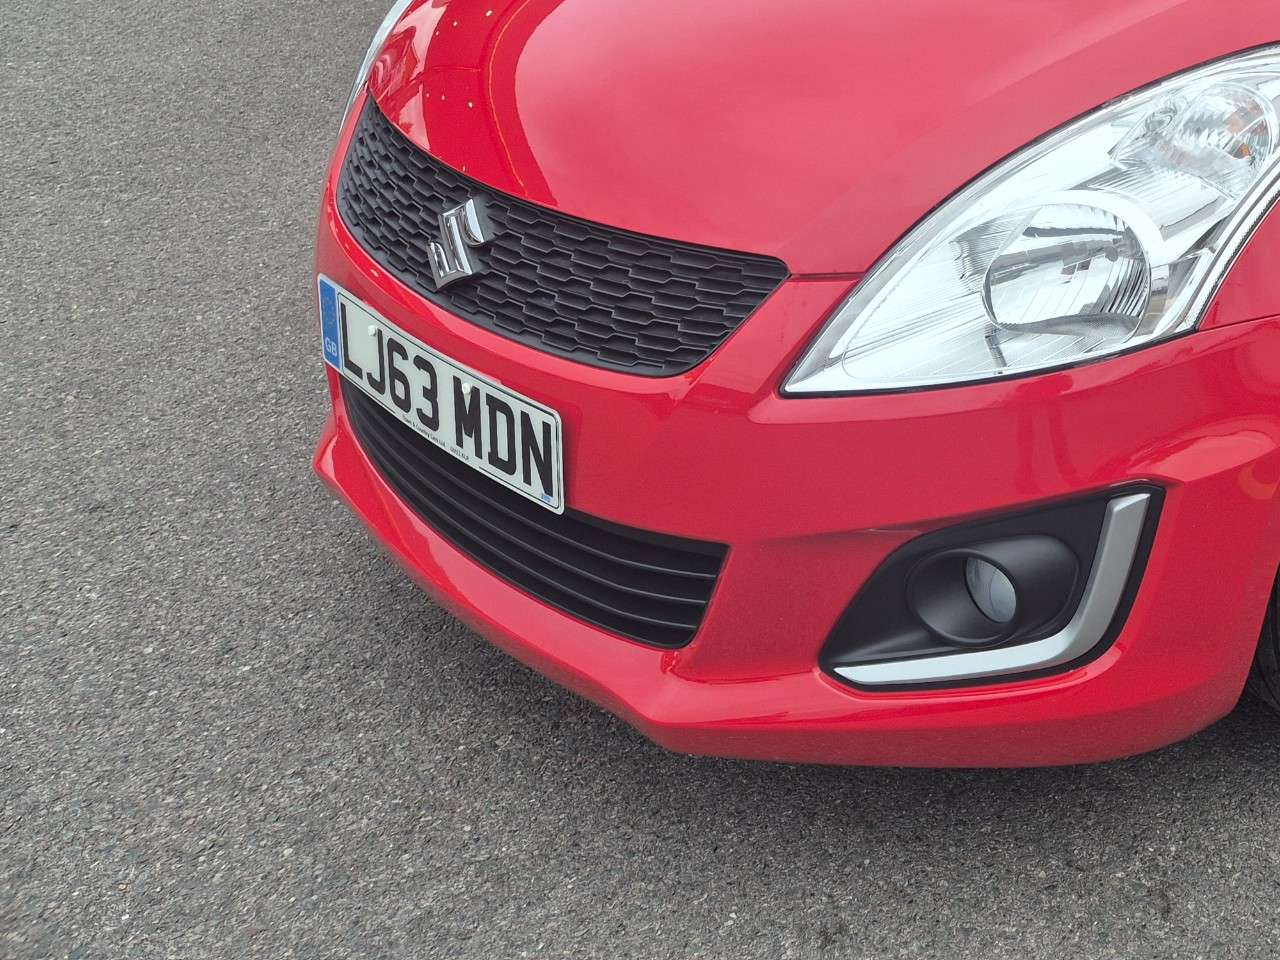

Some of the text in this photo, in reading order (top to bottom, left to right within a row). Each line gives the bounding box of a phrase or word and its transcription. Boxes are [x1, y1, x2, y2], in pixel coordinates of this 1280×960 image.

[324, 336, 338, 357] GB
[340, 302, 554, 497] LJ63 MDN
